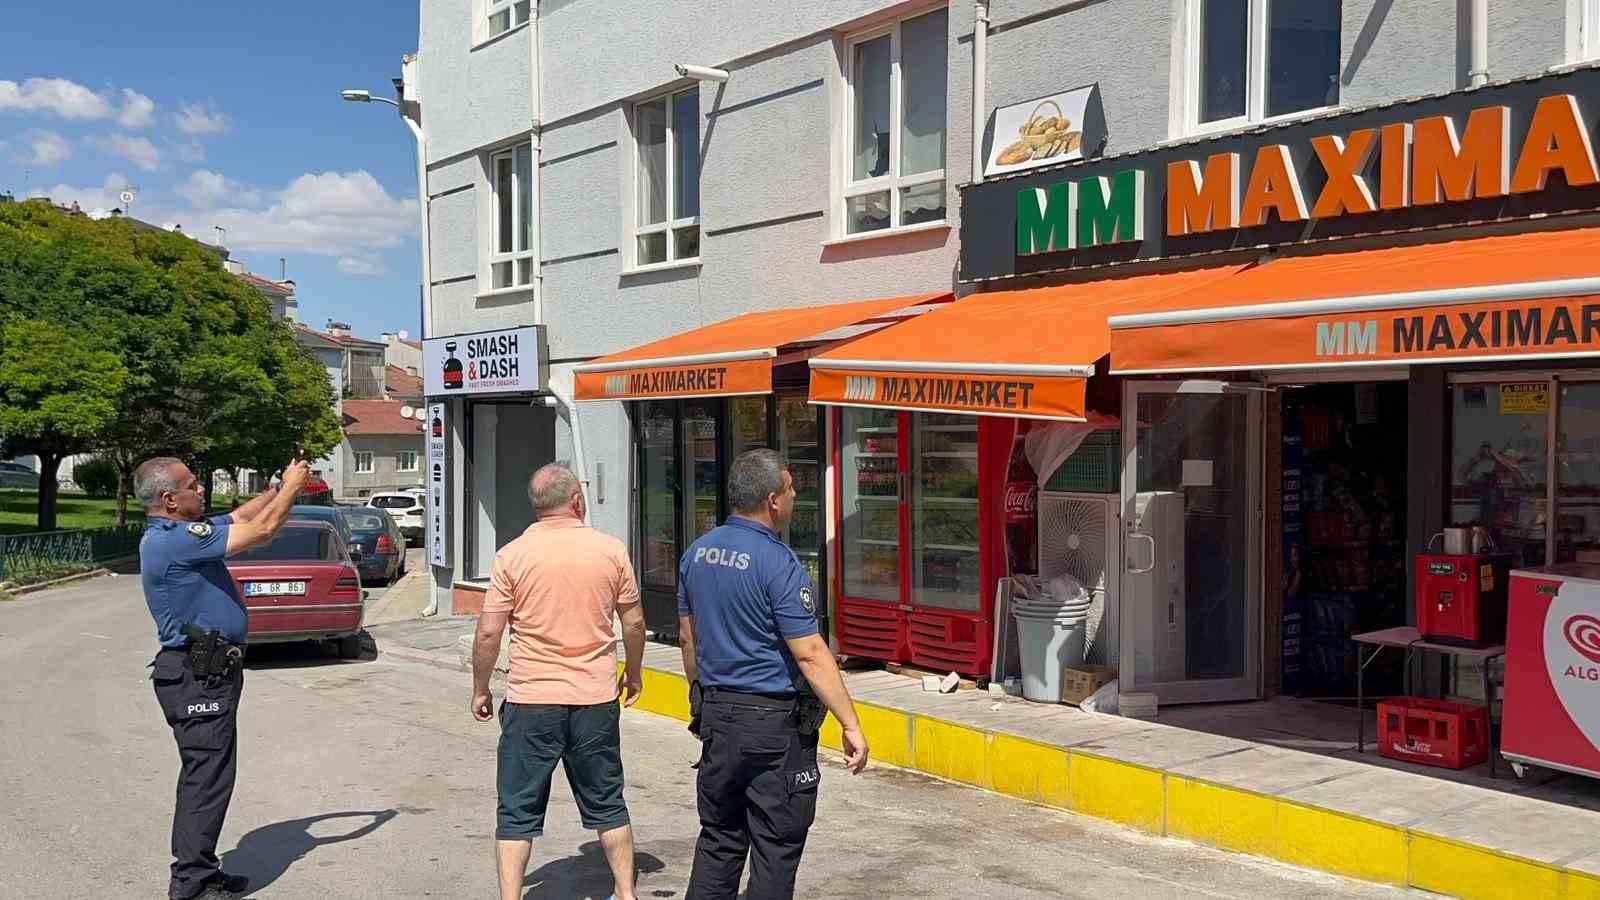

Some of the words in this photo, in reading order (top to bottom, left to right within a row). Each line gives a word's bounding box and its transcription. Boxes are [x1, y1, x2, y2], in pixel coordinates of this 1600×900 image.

[1017, 169, 1144, 256] MM
[467, 334, 518, 359] SMASH
[1316, 320, 1377, 356] MM
[468, 361, 477, 380] &
[480, 358, 519, 379] DASH
[629, 367, 727, 394] MAXIMARKET
[880, 377, 1034, 409] MAXIMARKET
[251, 583, 262, 592] 26
[1564, 665, 1599, 681] ALG
